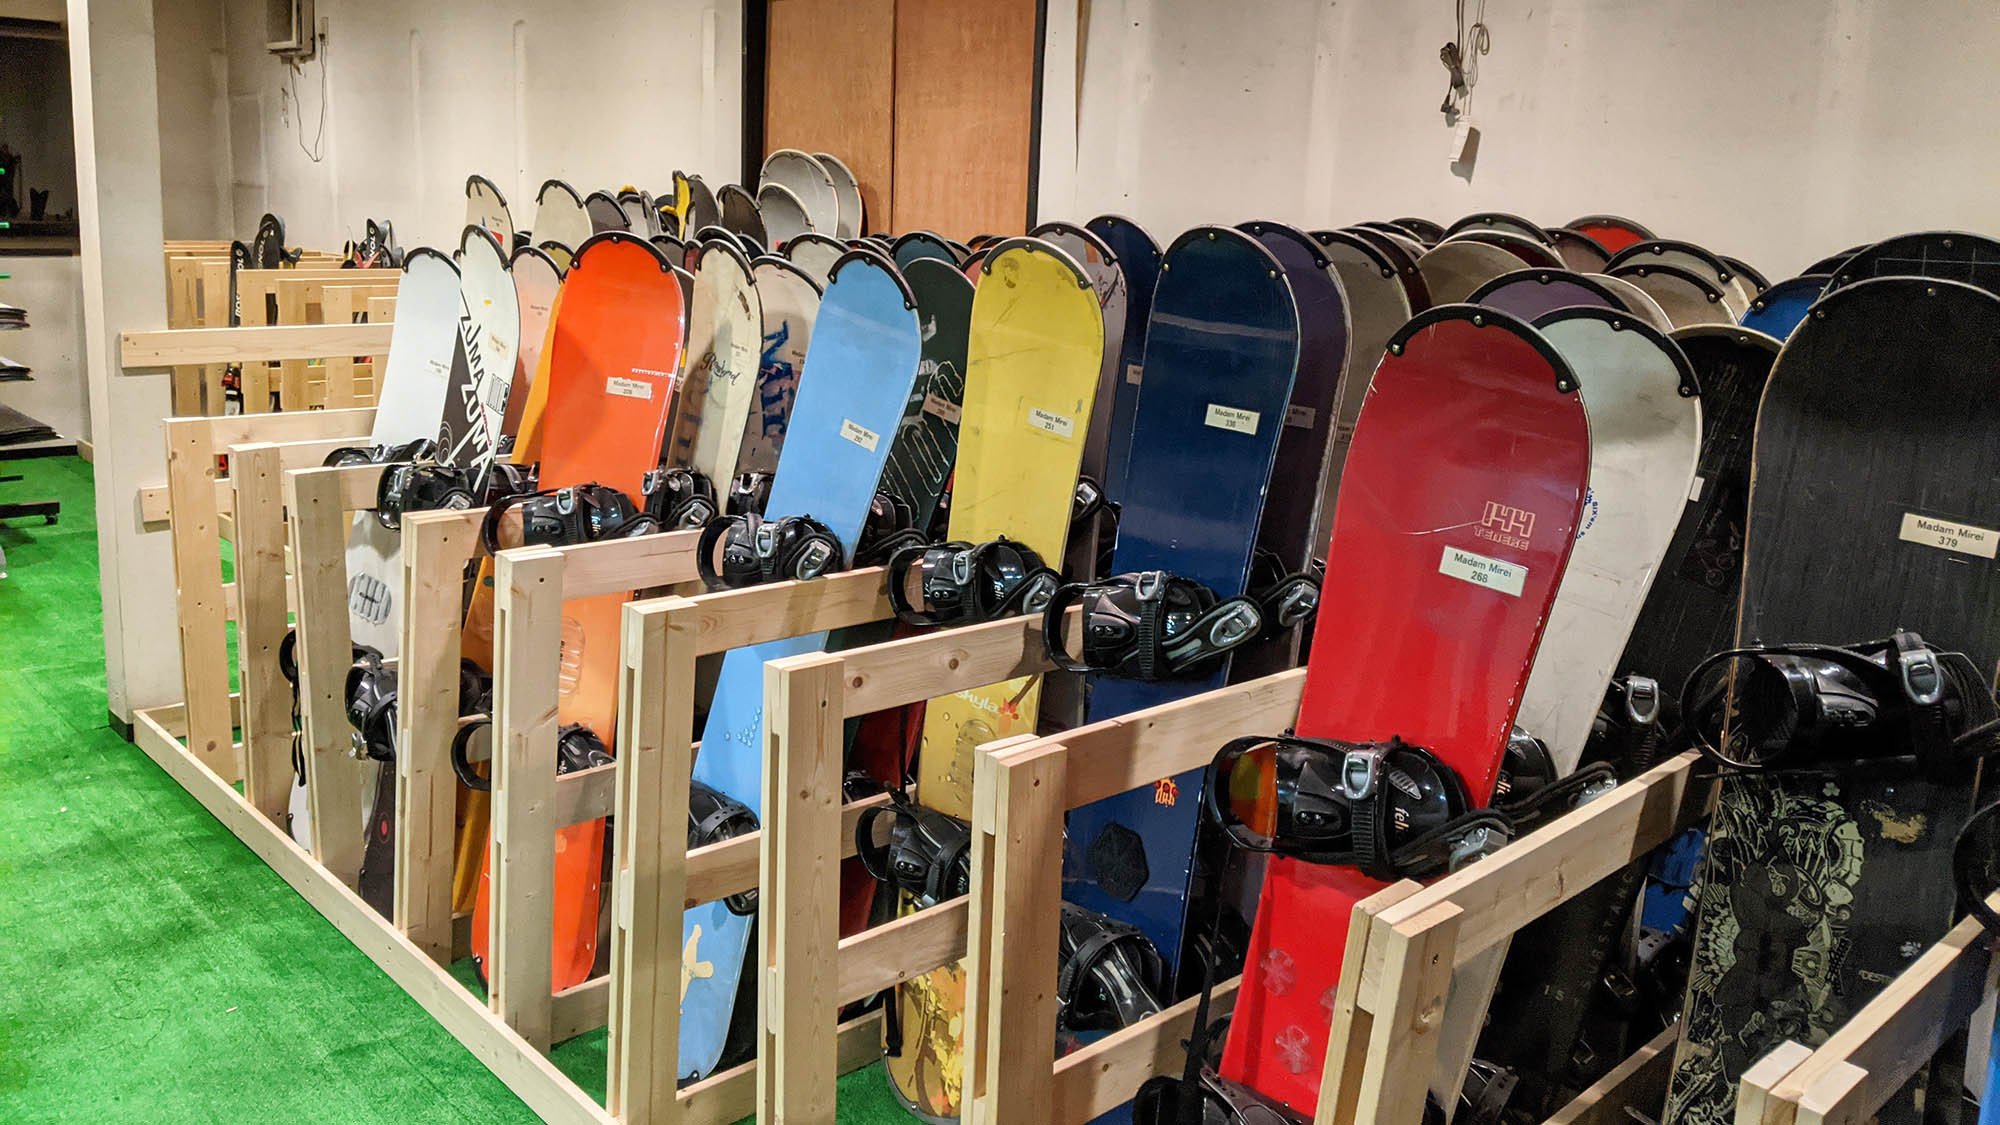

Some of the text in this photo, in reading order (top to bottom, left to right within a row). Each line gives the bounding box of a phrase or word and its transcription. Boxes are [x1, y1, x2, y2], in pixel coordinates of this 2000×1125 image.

[459, 287, 485, 392] ZUMA
[449, 384, 494, 494] ZUMA
[1917, 519, 1985, 541] Madam Mirei
[1938, 535, 1958, 548] 379
[1454, 552, 1512, 578] Madam Mirei
[1471, 570, 1489, 583] 268
